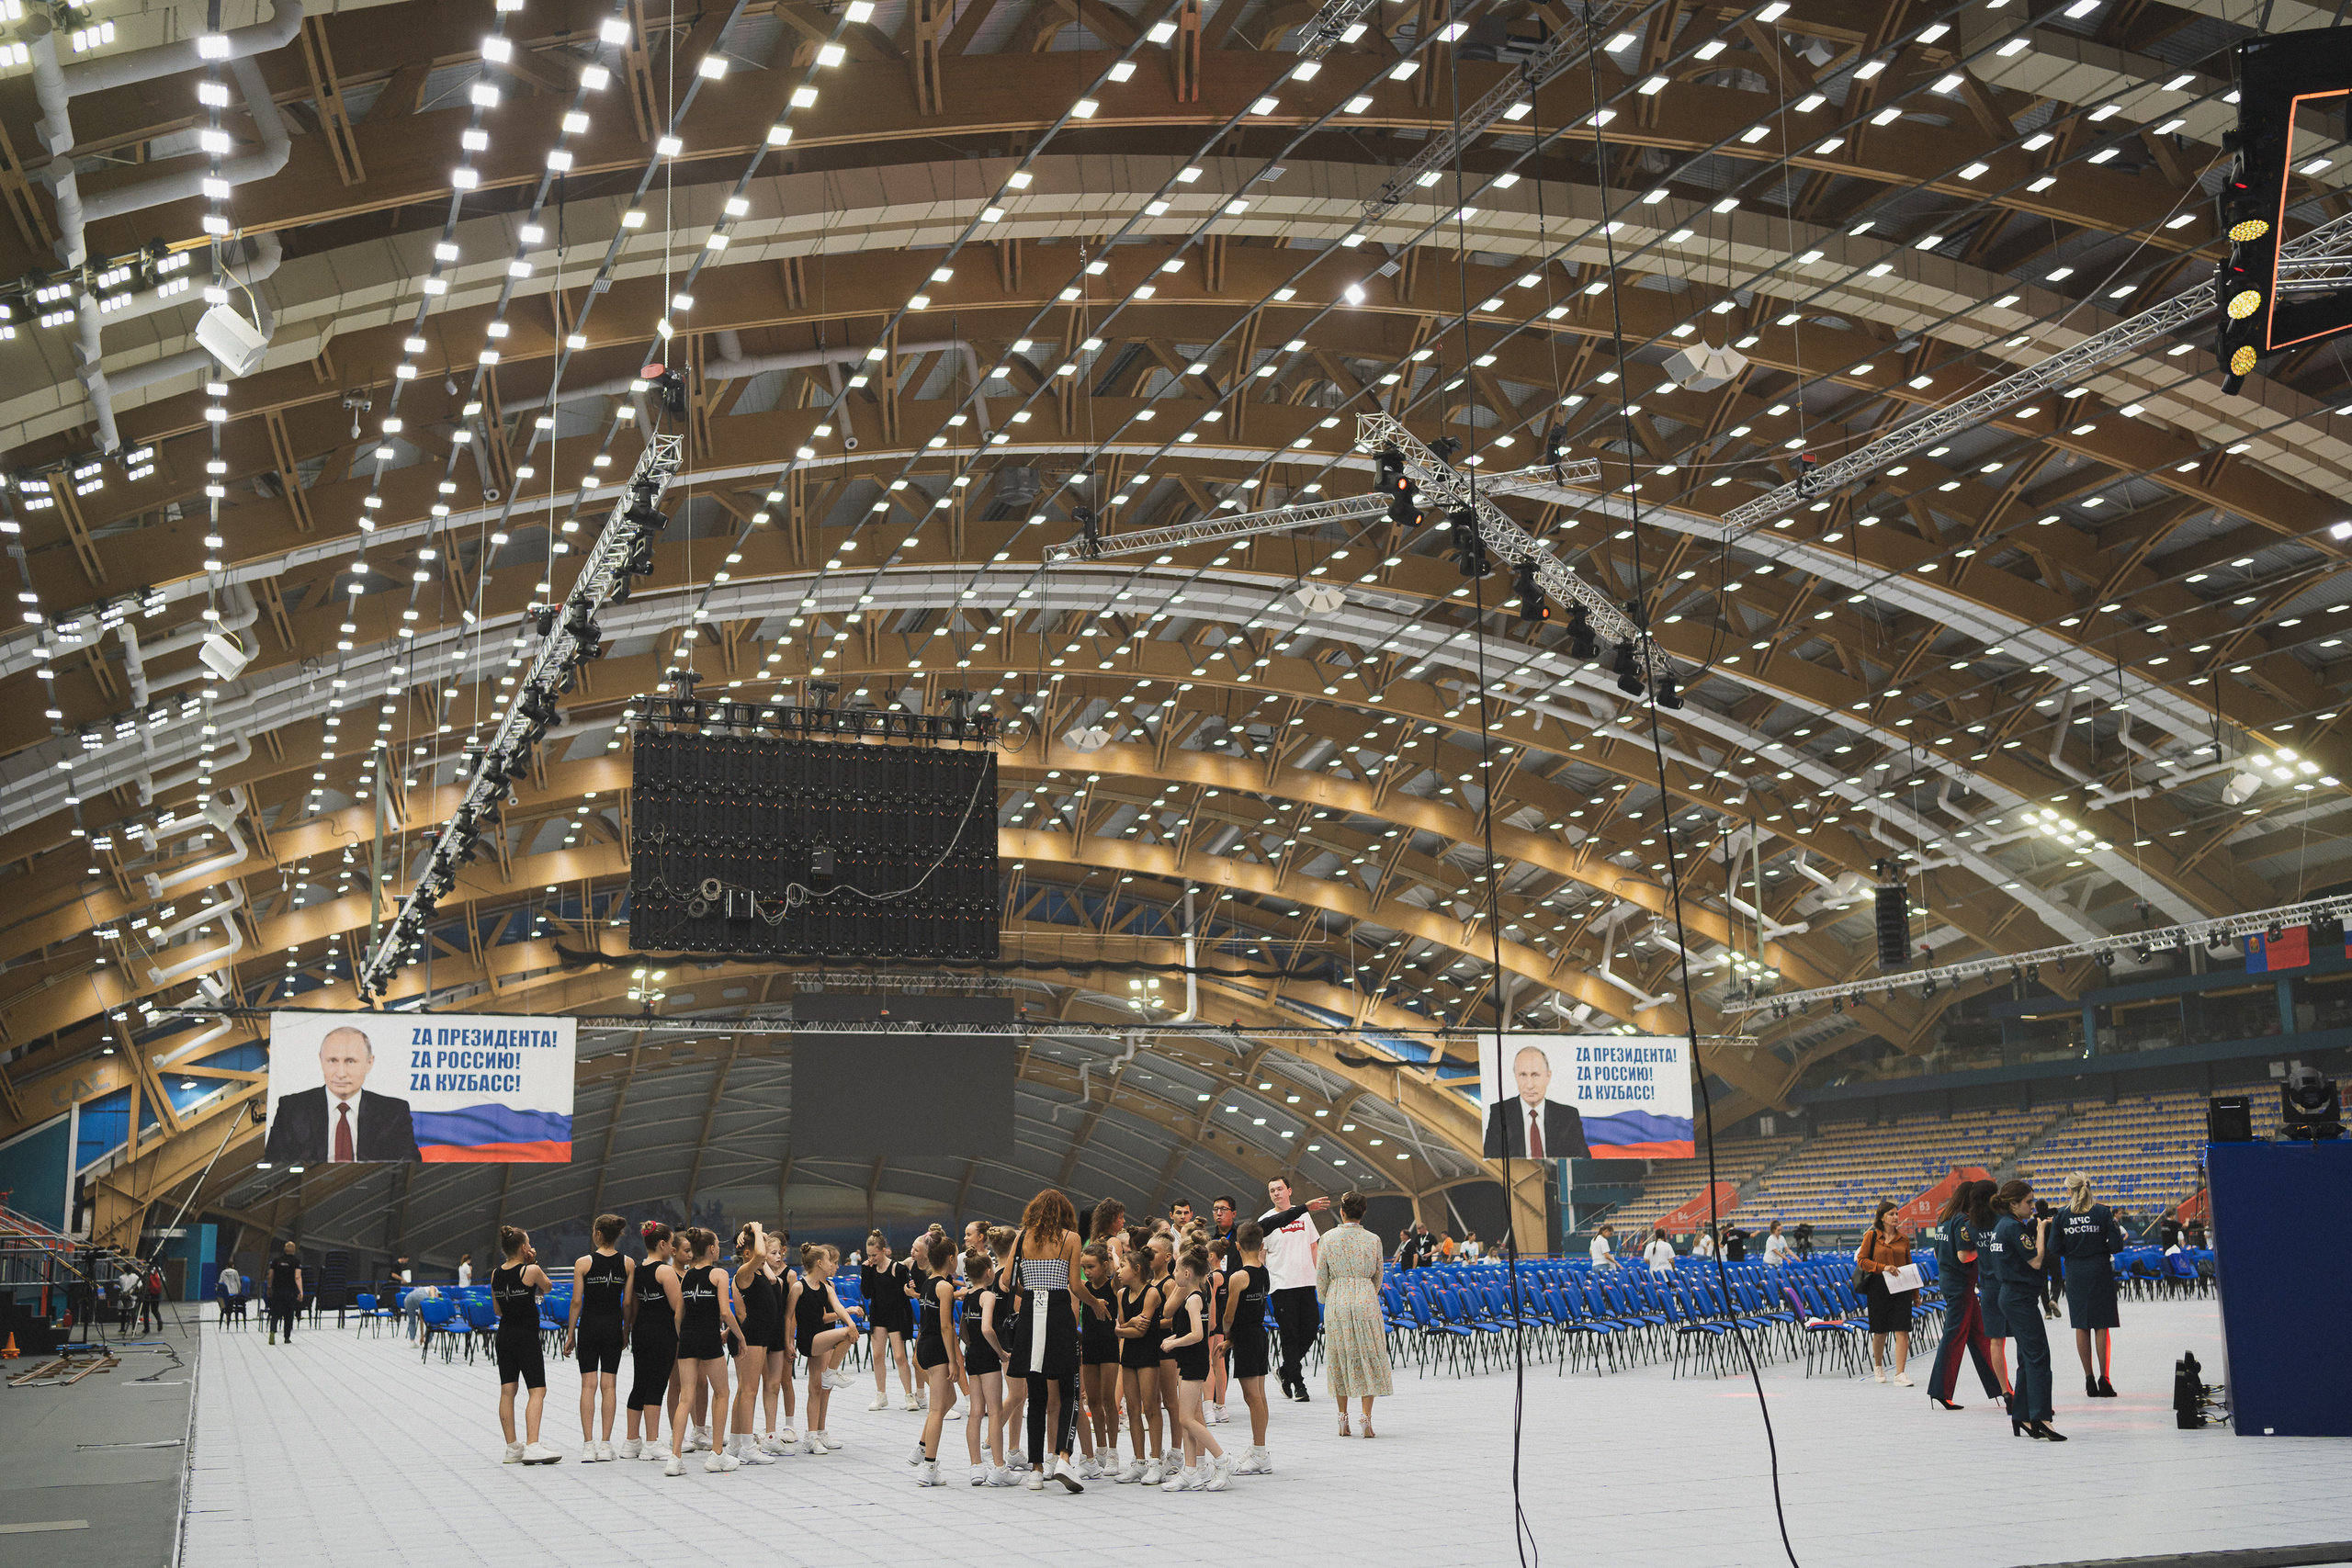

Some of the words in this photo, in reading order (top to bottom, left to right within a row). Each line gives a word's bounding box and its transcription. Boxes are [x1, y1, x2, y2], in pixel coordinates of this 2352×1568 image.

[412, 1028, 433, 1046] ZA
[437, 1029, 558, 1050] ПРЕЗИДЕНТА!
[411, 1051, 432, 1068] ZA
[436, 1051, 521, 1069] РОССИЮ!
[1576, 1047, 1591, 1062] ZA
[1594, 1047, 1677, 1065] ПРЕЗИДЕНТА!
[1577, 1066, 1592, 1081] ZA
[1594, 1066, 1654, 1081] РОССИЮ!
[410, 1073, 431, 1091] ZA
[435, 1074, 521, 1092] КУZБАСС!
[1577, 1085, 1593, 1100] ZA
[1595, 1085, 1655, 1100] КУZБАСС!
[2069, 1215, 2091, 1225] МЧС
[2064, 1224, 2100, 1235] РОССИИ
